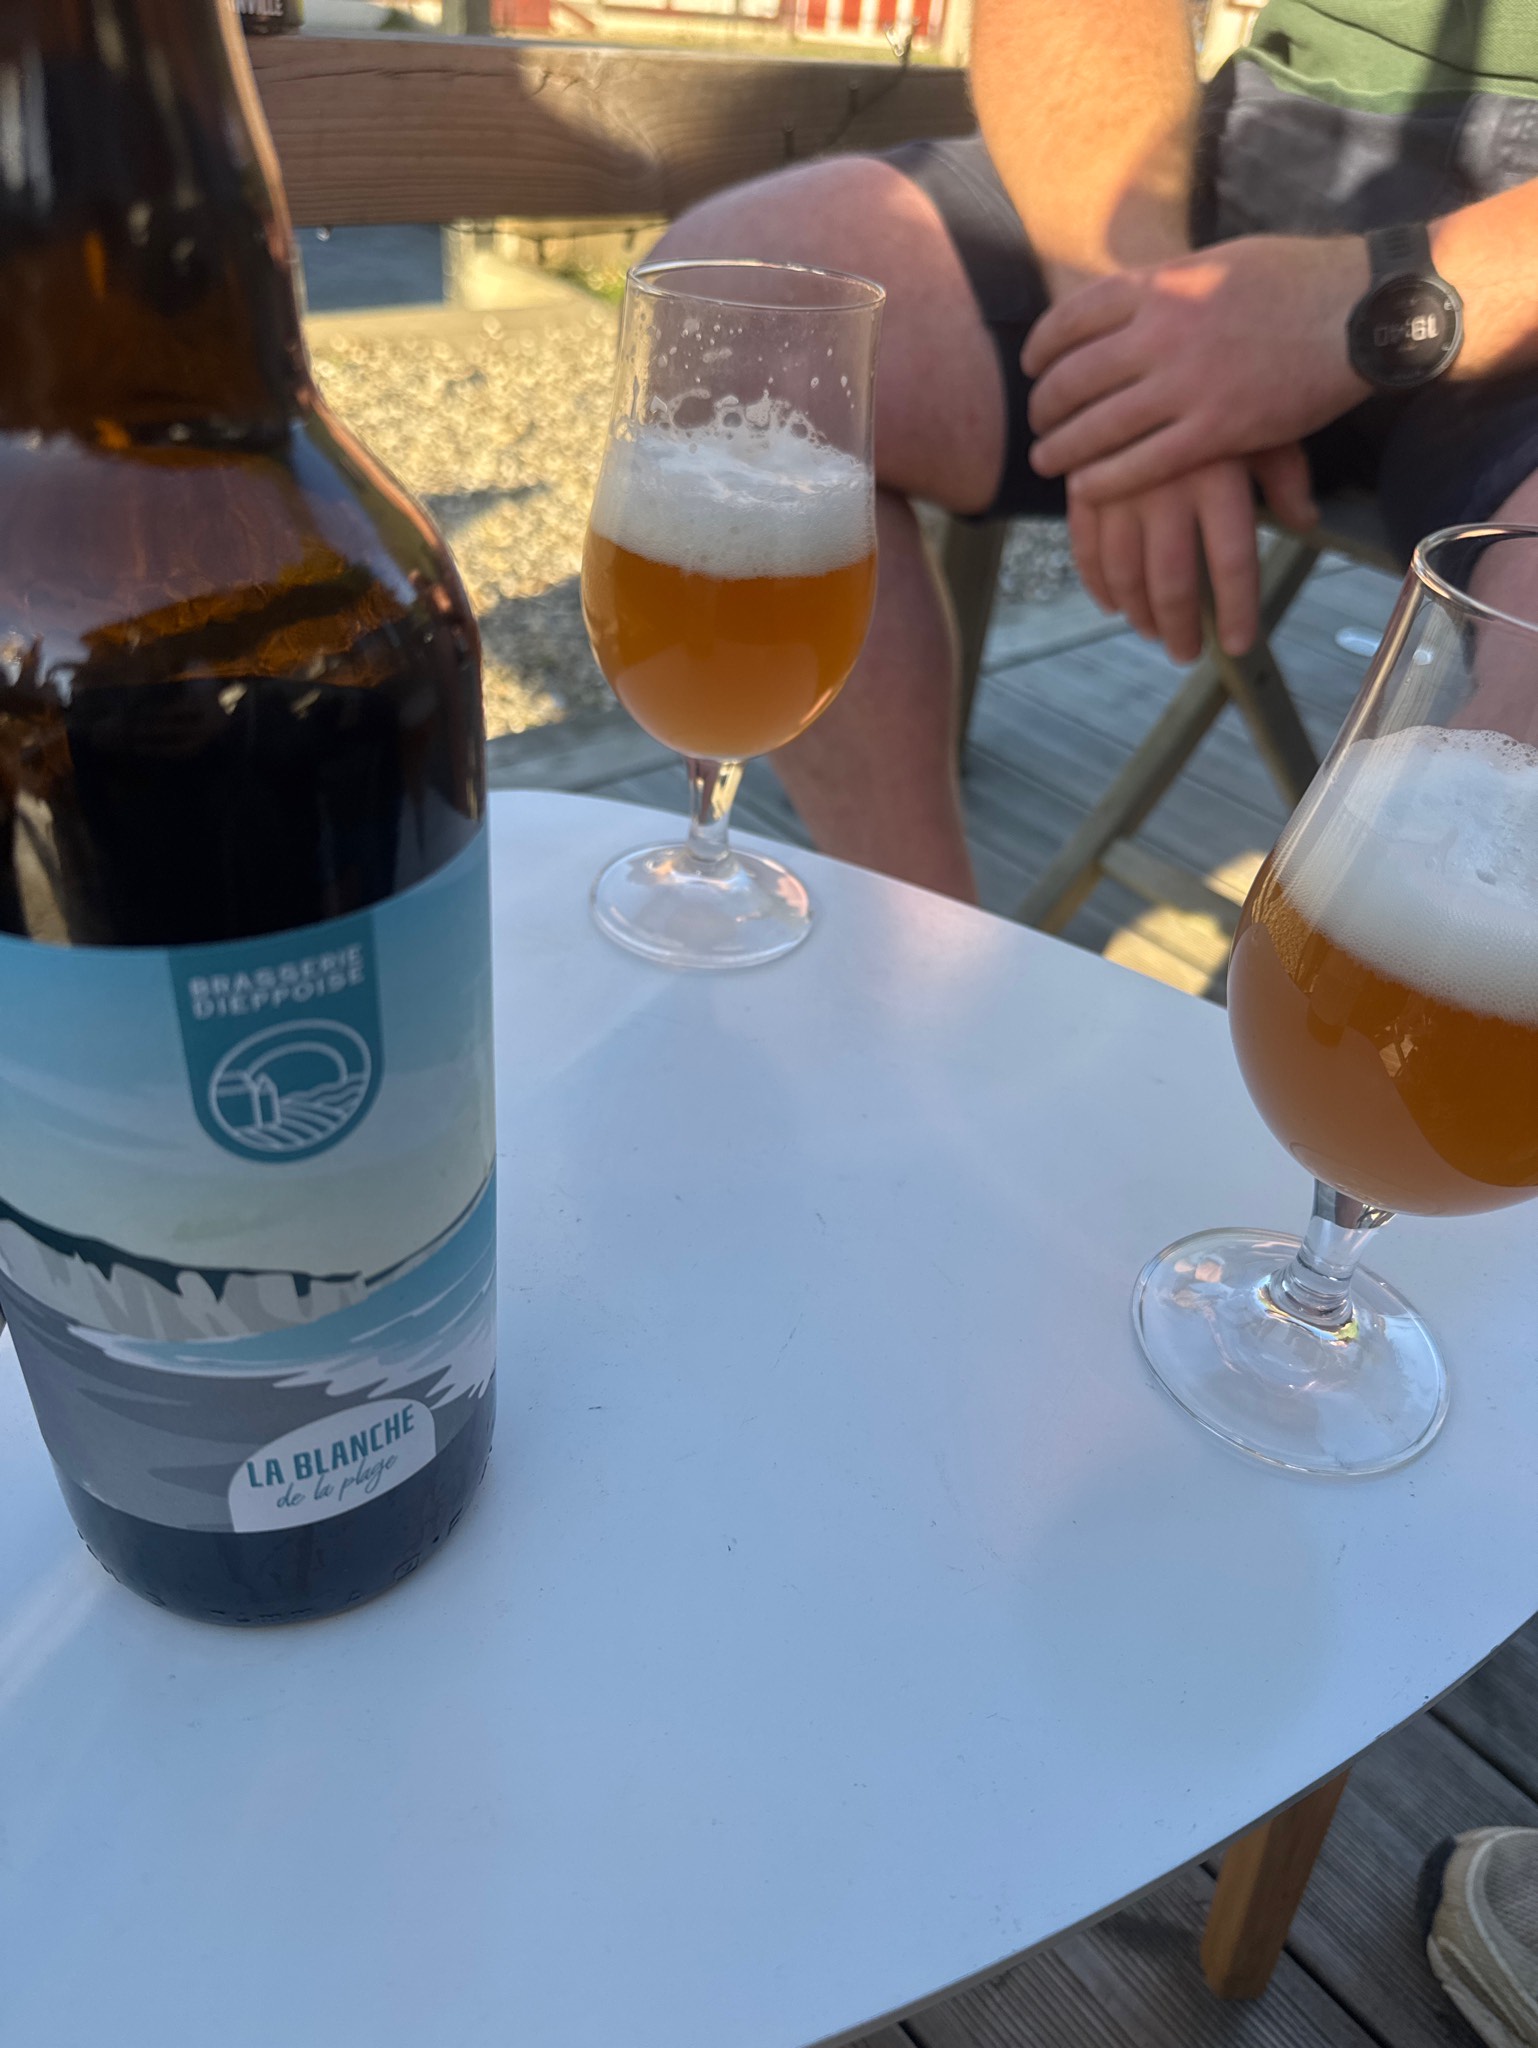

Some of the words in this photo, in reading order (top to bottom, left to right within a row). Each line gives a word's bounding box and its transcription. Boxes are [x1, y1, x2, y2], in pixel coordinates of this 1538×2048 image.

[189, 943, 363, 997] BRASSERIE
[192, 966, 364, 1020] DIEPPOISE
[247, 1457, 285, 1488] LA
[293, 1403, 414, 1480] BLANCHE
[276, 1482, 306, 1508] de
[314, 1475, 335, 1500] la
[339, 1454, 398, 1501] plage
